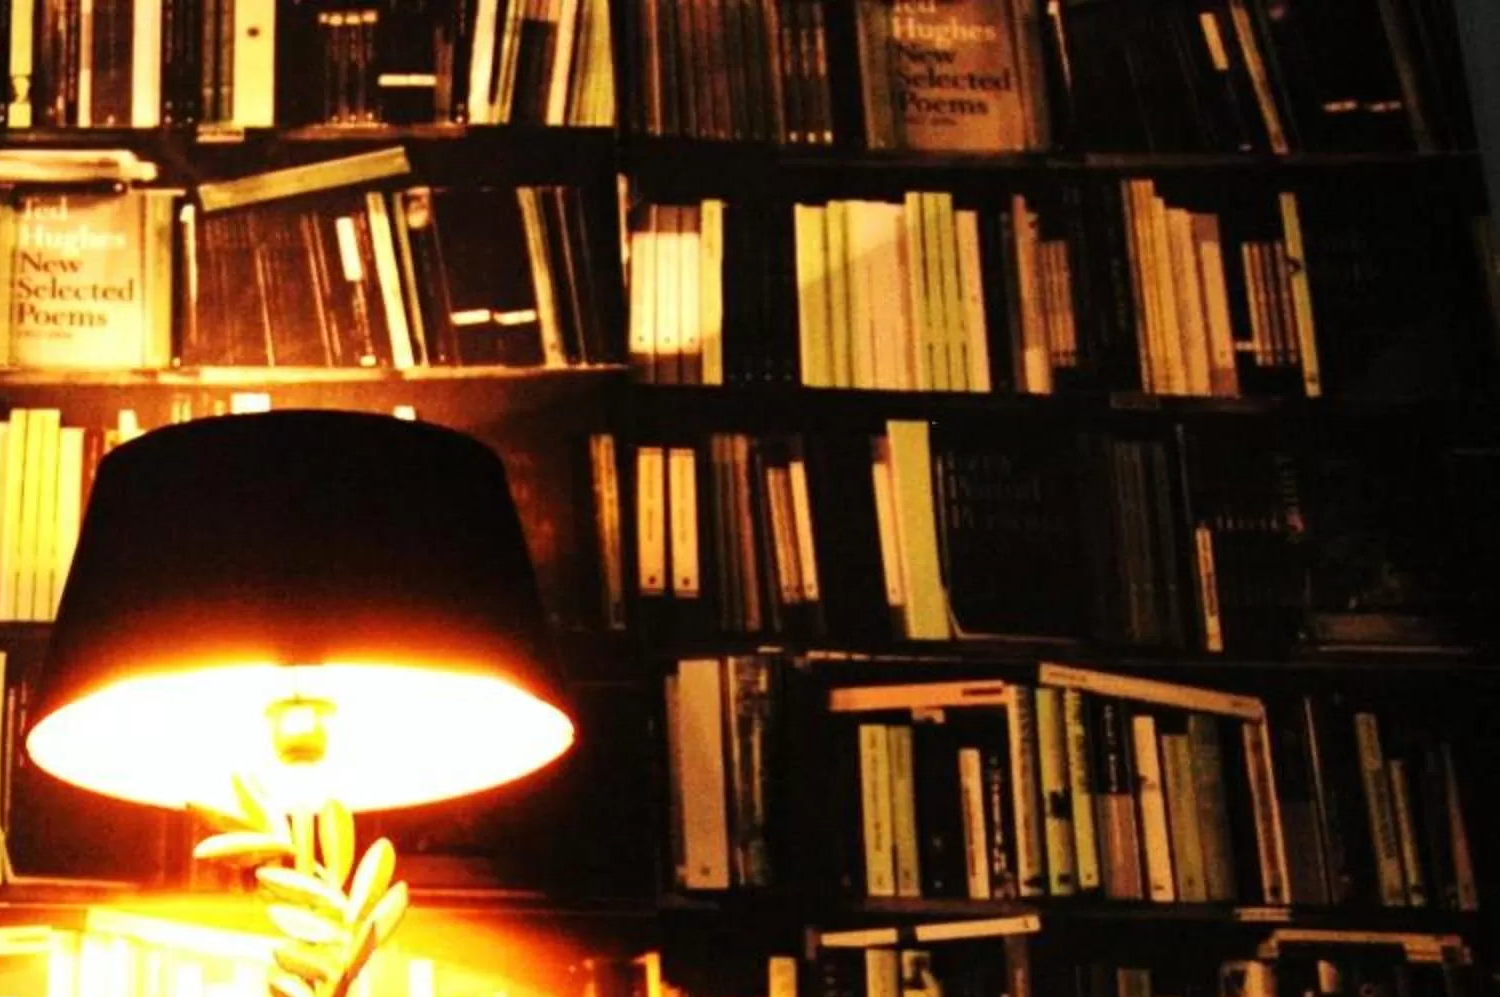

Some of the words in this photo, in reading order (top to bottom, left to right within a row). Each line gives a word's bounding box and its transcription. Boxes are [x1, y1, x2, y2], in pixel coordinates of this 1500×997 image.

[892, 15, 997, 49] Hughes
[898, 42, 957, 64] New
[896, 67, 1011, 92] Selected
[899, 90, 990, 115] Poems
[24, 196, 69, 222] Ted
[19, 223, 127, 257] Hughes
[18, 250, 83, 273] New
[15, 276, 135, 301] Selected
[16, 302, 109, 328] Poems
